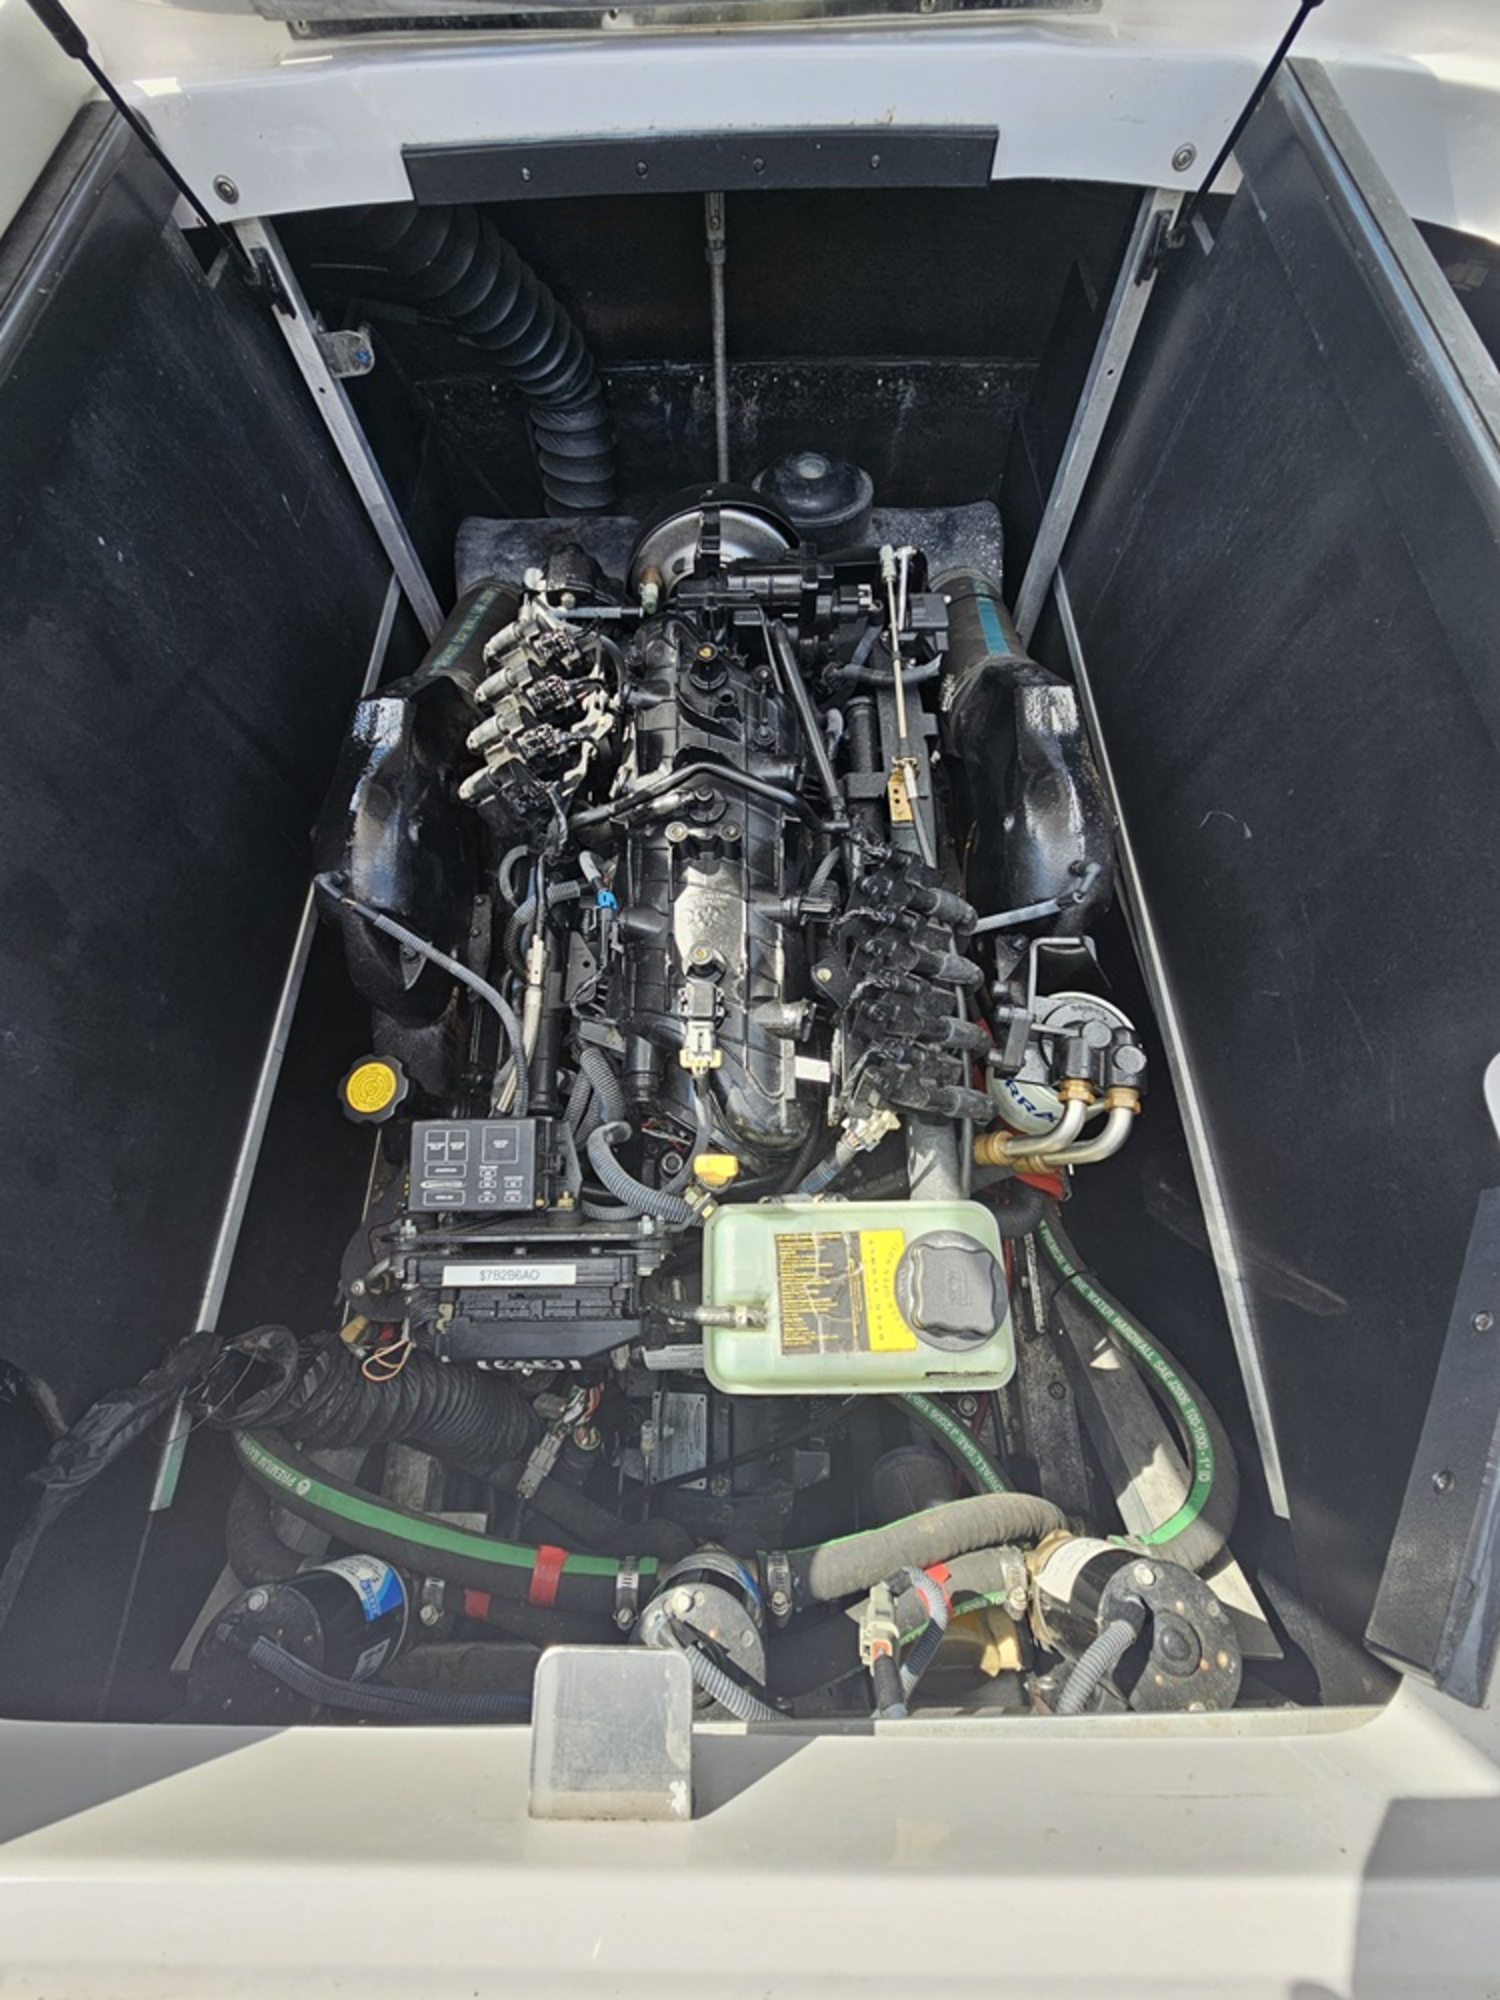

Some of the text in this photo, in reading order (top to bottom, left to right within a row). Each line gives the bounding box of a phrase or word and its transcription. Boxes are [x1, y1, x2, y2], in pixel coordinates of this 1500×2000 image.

[1005, 1080, 1058, 1122] RRA
[1087, 1291, 1115, 1320] WATER
[1112, 1316, 1155, 1361] HARDWALL
[1153, 1359, 1177, 1382] SAE
